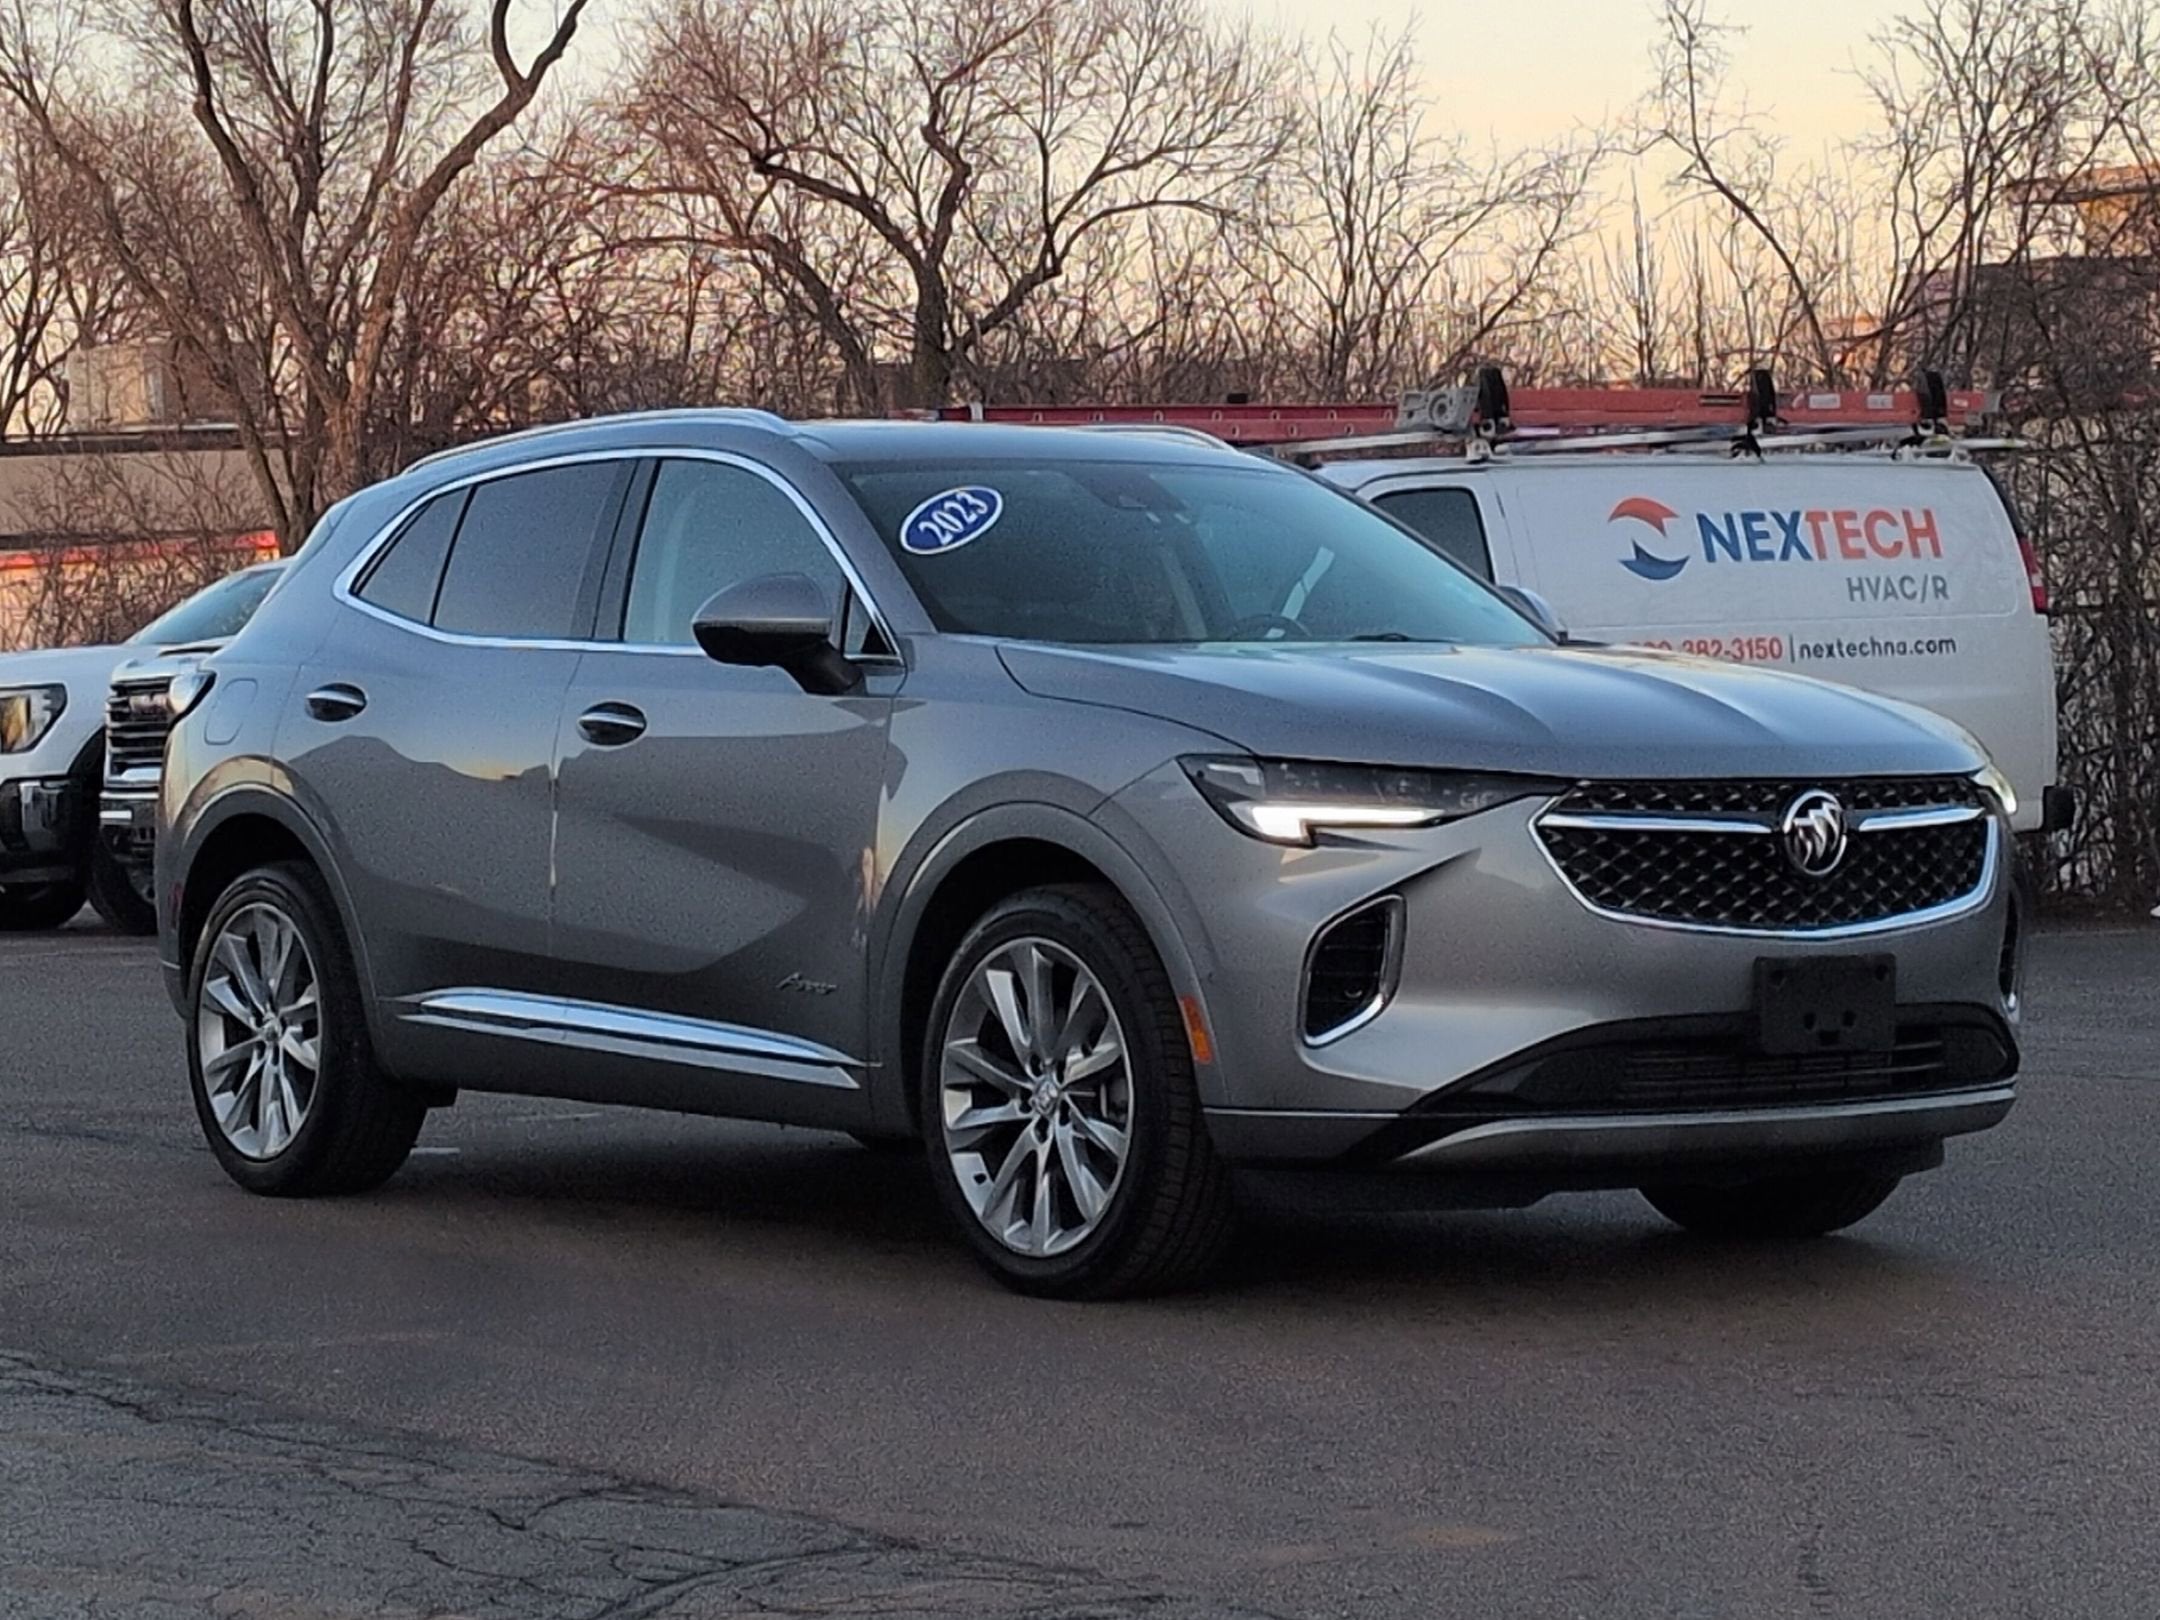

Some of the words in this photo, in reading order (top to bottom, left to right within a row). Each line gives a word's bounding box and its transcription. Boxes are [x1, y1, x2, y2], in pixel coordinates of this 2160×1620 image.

[918, 491, 988, 545] 2023
[1696, 508, 1943, 563] NEXTECH
[1847, 574, 1950, 604] HVAC/R
[1800, 636, 1957, 660] nextechna.com
